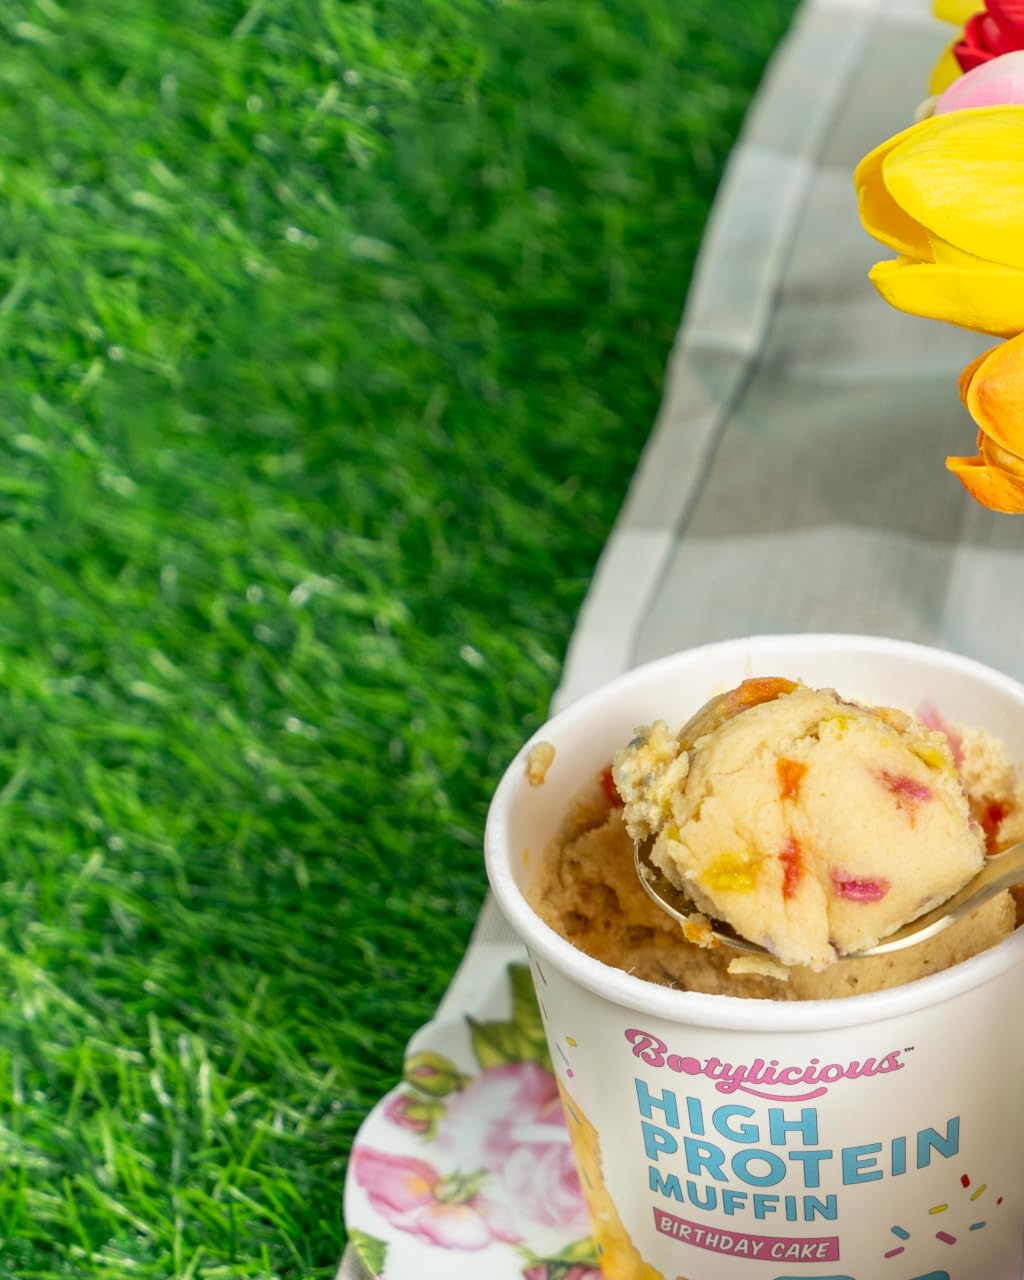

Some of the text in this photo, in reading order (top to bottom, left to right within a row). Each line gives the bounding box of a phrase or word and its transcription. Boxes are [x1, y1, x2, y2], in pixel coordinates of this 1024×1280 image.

[635, 1078, 819, 1146] HIGH
[641, 1116, 960, 1188] PROTEIN
[649, 1165, 838, 1222] MUFFIN
[660, 1216, 831, 1259] BIRTHDAY CAKE
